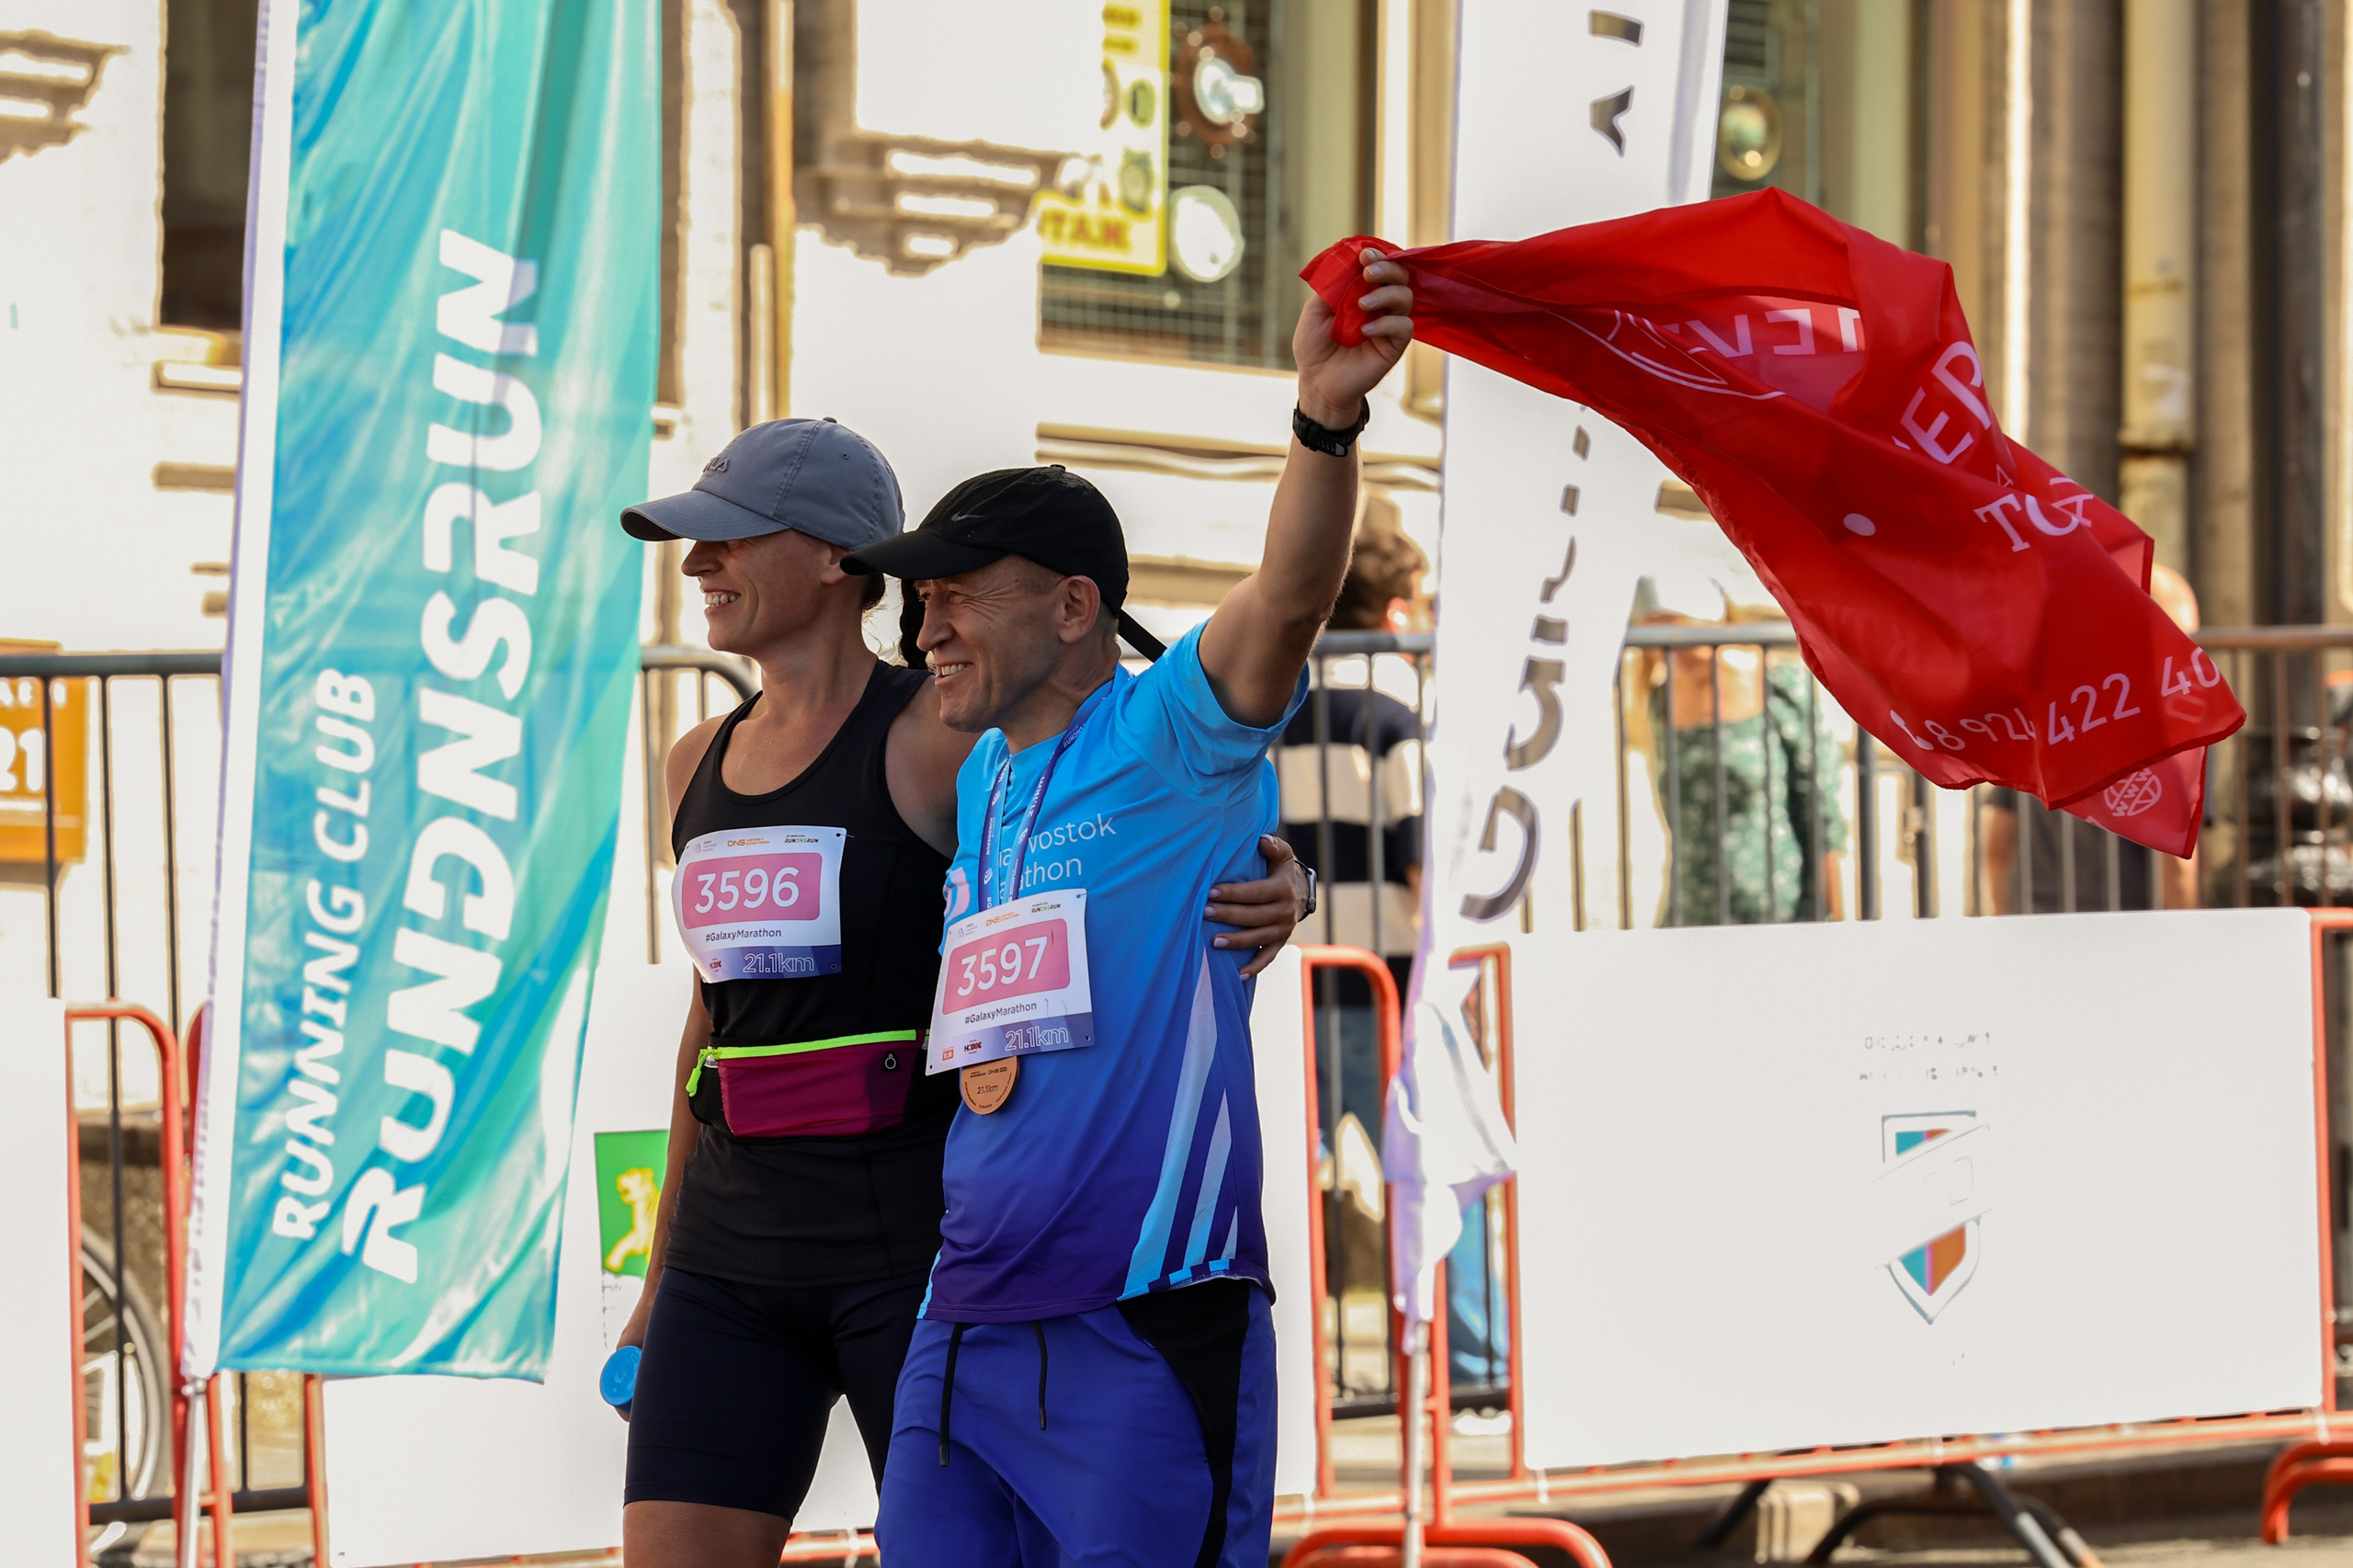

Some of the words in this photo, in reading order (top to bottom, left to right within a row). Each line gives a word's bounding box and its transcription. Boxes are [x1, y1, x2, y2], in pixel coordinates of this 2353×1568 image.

[2047, 672, 2142, 746] 422
[313, 667, 376, 863] CLUB
[341, 226, 543, 1284] RUNDNSRUN
[727, 838, 746, 847] DNS
[694, 867, 800, 914] 3596
[705, 927, 781, 943] #GalaxyMarathon
[743, 953, 814, 973] 21.1km
[957, 936, 1048, 997] 3597
[964, 1001, 1038, 1025] #GalaxyMarathon
[272, 878, 367, 1241] RUNNING
[1005, 1026, 1069, 1051] 21.1km
